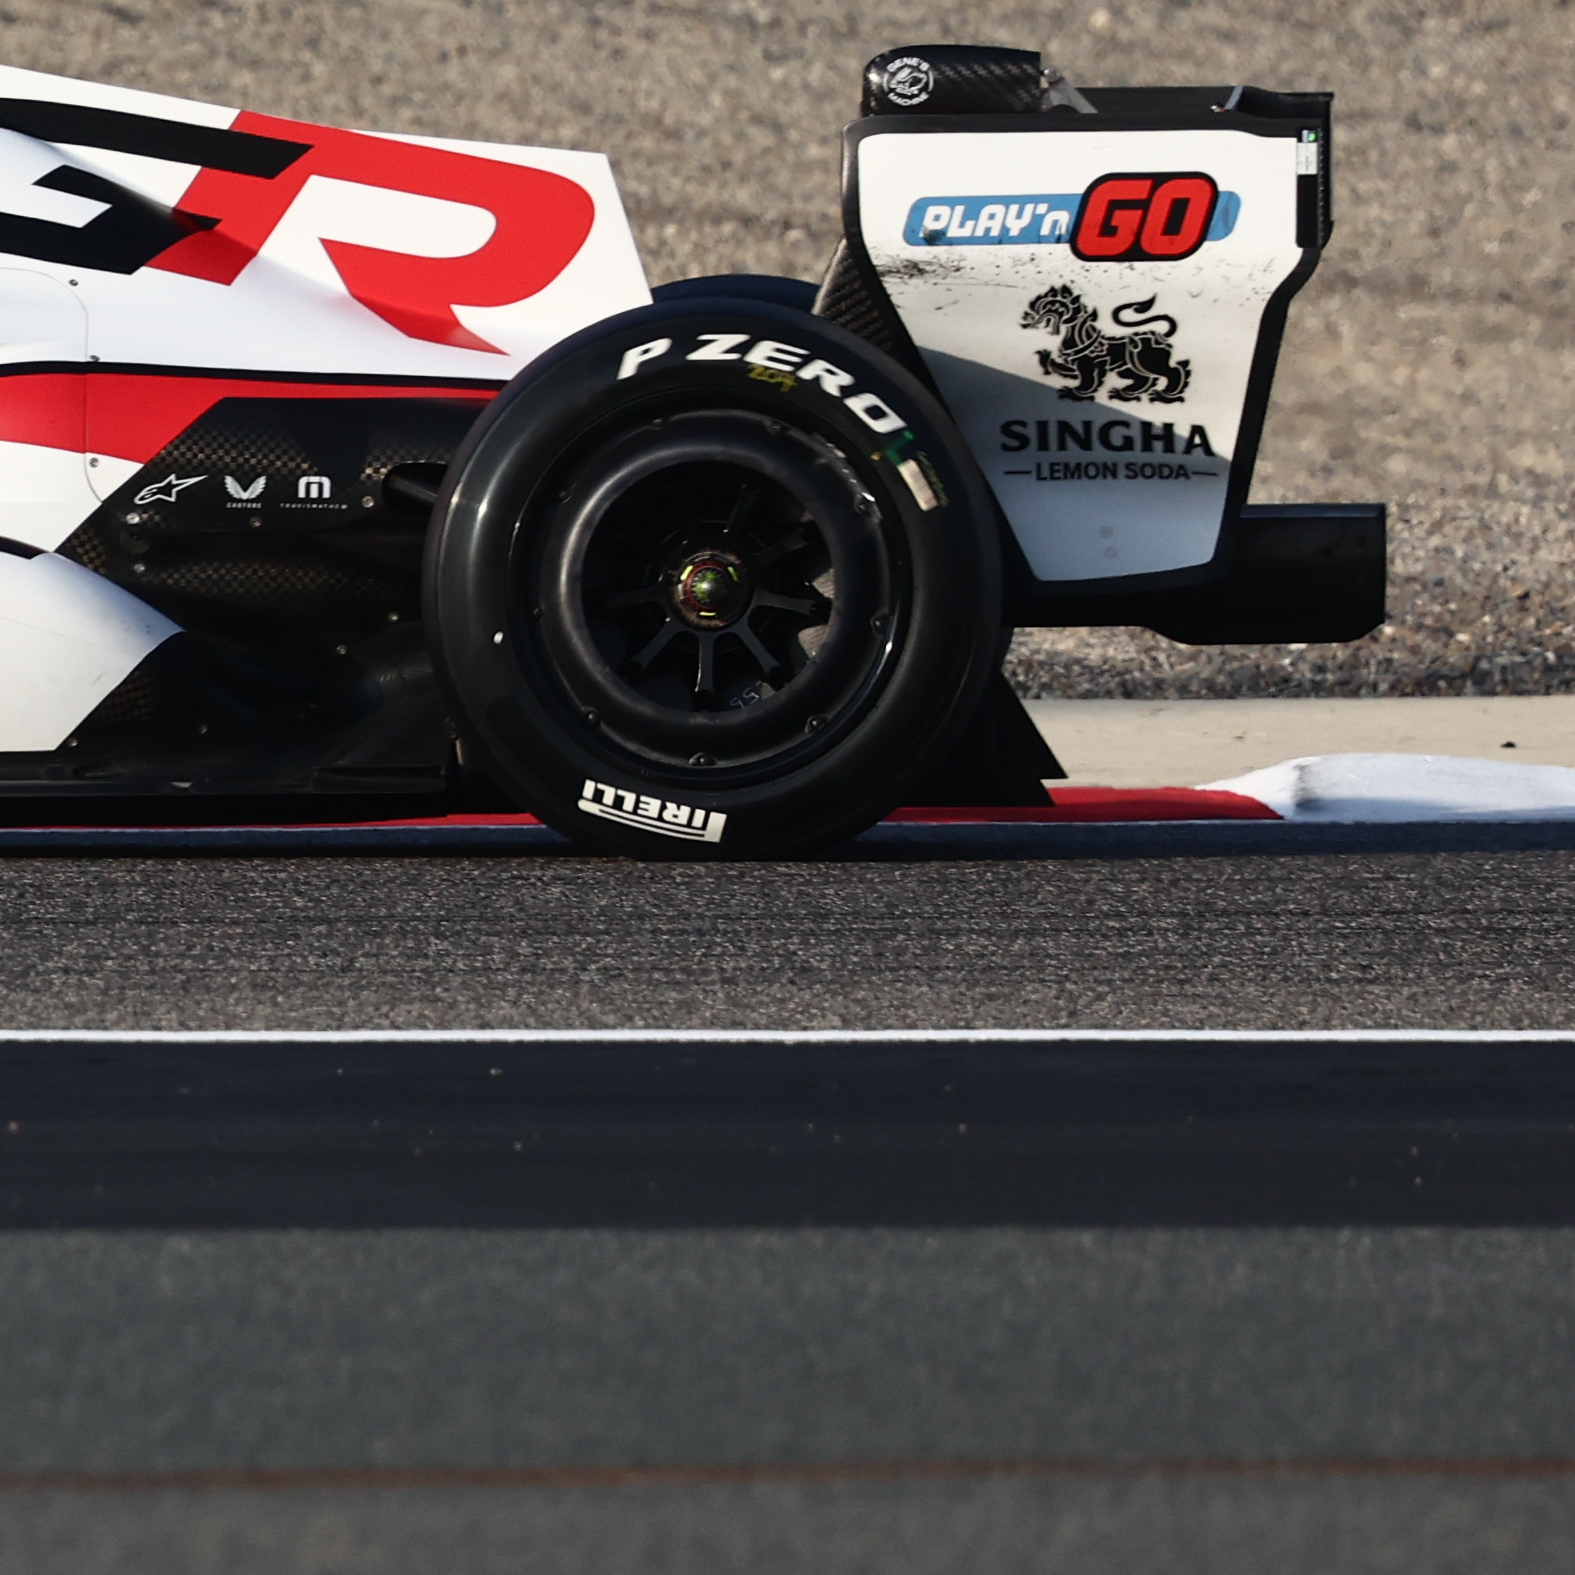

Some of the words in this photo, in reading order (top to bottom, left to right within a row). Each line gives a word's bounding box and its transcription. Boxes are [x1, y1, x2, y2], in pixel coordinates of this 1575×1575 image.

[1075, 177, 1218, 257] GO
[617, 337, 672, 380] P
[686, 333, 909, 435] ZERO
[1000, 419, 1216, 457] SINGHA
[1035, 462, 1118, 482] LEMON
[1124, 462, 1191, 481] SODA
[577, 778, 728, 844] PIRELLI
